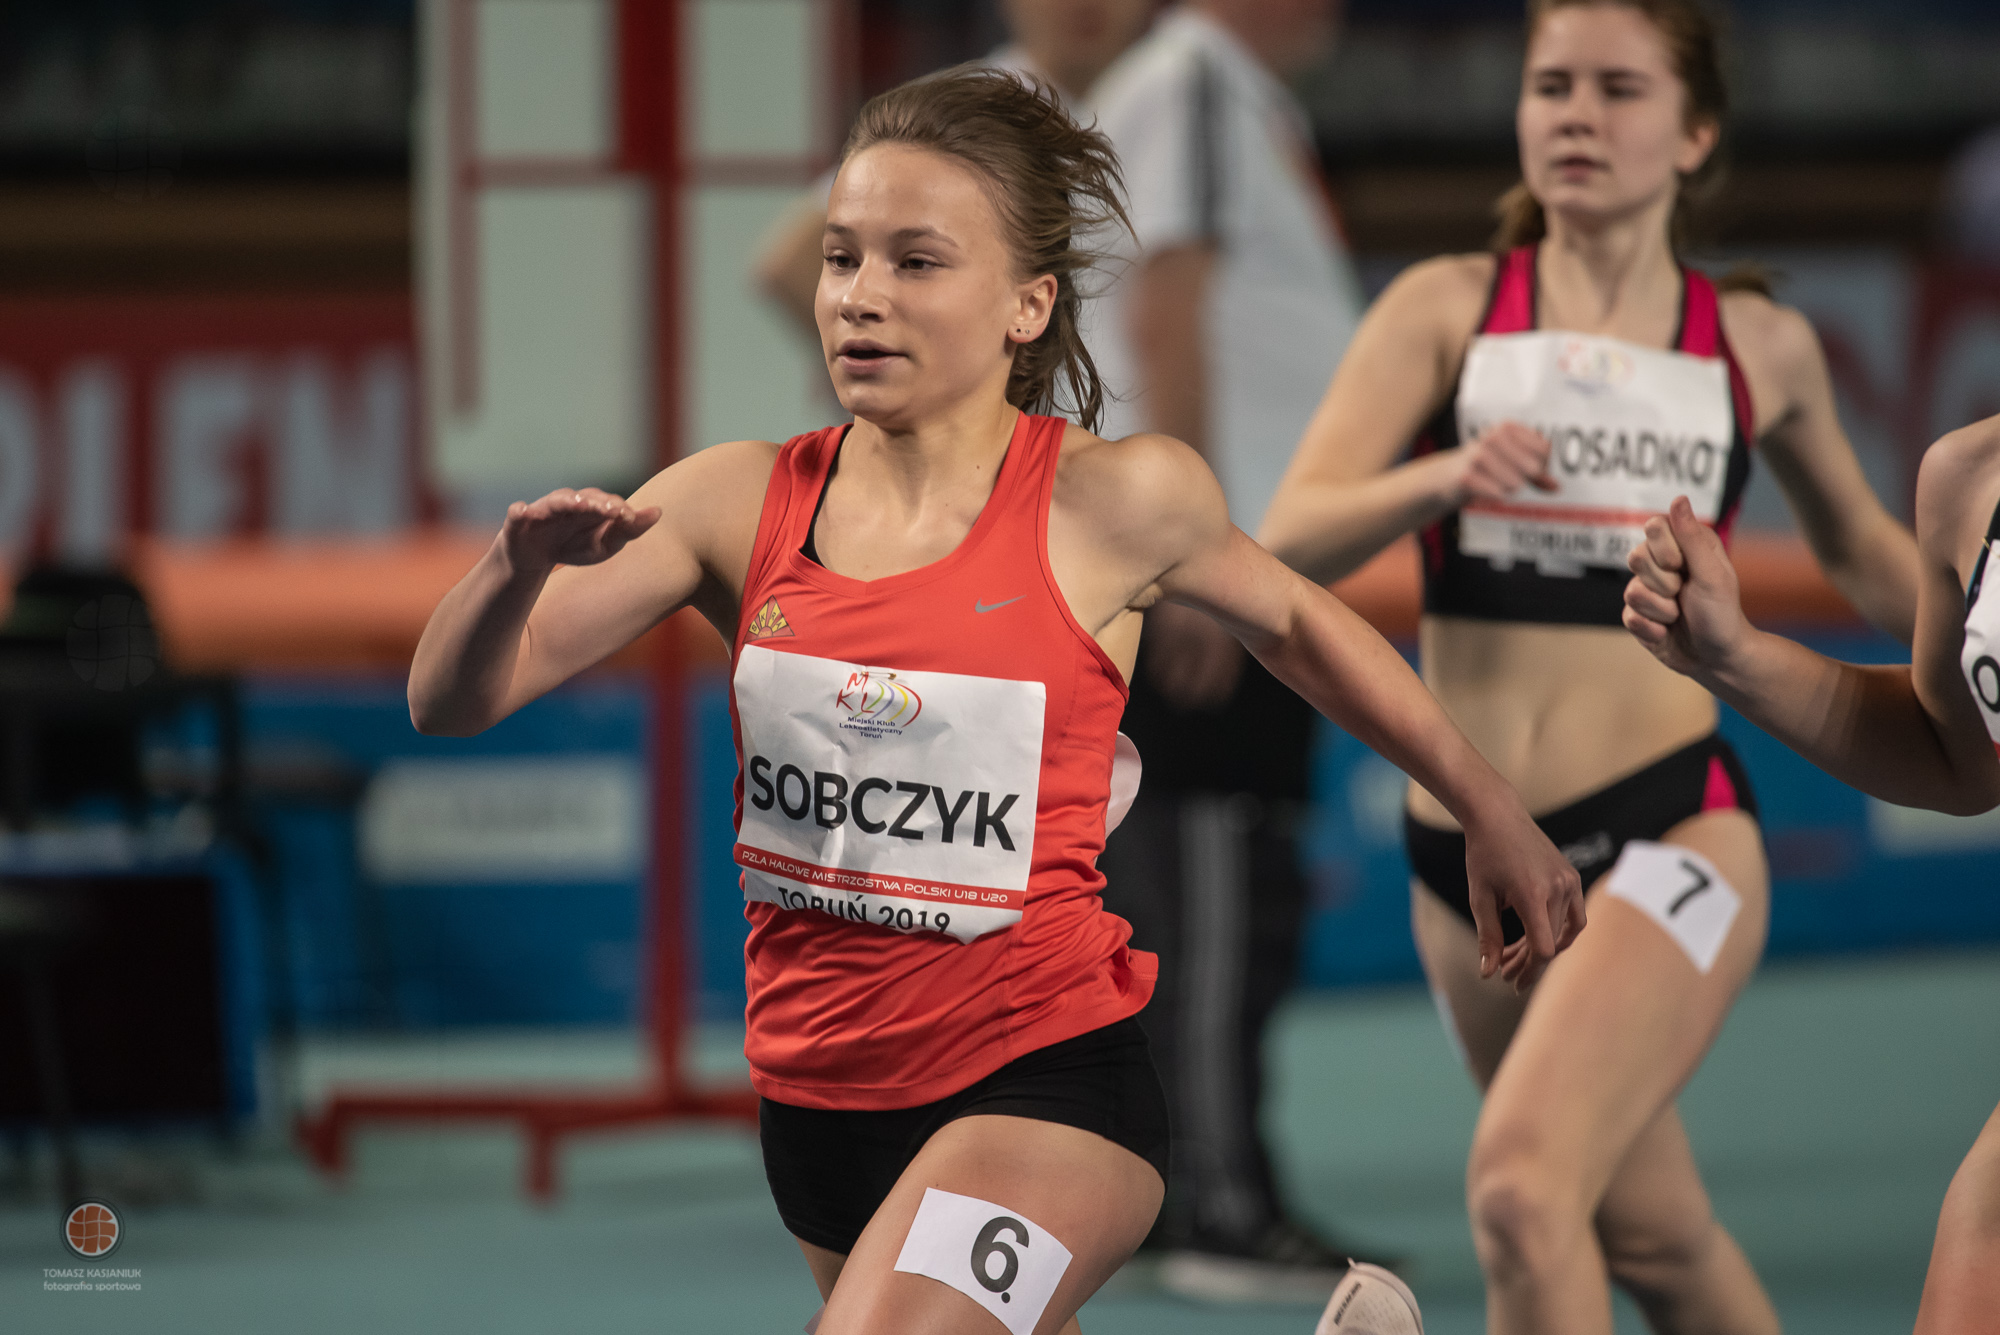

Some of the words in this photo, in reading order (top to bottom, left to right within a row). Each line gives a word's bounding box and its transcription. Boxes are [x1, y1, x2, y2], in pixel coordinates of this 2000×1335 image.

[848, 717, 875, 725] Miejski
[749, 755, 1021, 852] SOBCZYK
[742, 851, 768, 867] PZLA
[769, 858, 810, 878] HALOWE
[812, 870, 901, 892] MISTRZOSTWA
[904, 883, 951, 898] POLSKI
[954, 890, 978, 901] U18
[981, 892, 1008, 903] U20
[1668, 858, 1710, 918] 7
[878, 905, 951, 934] 2019
